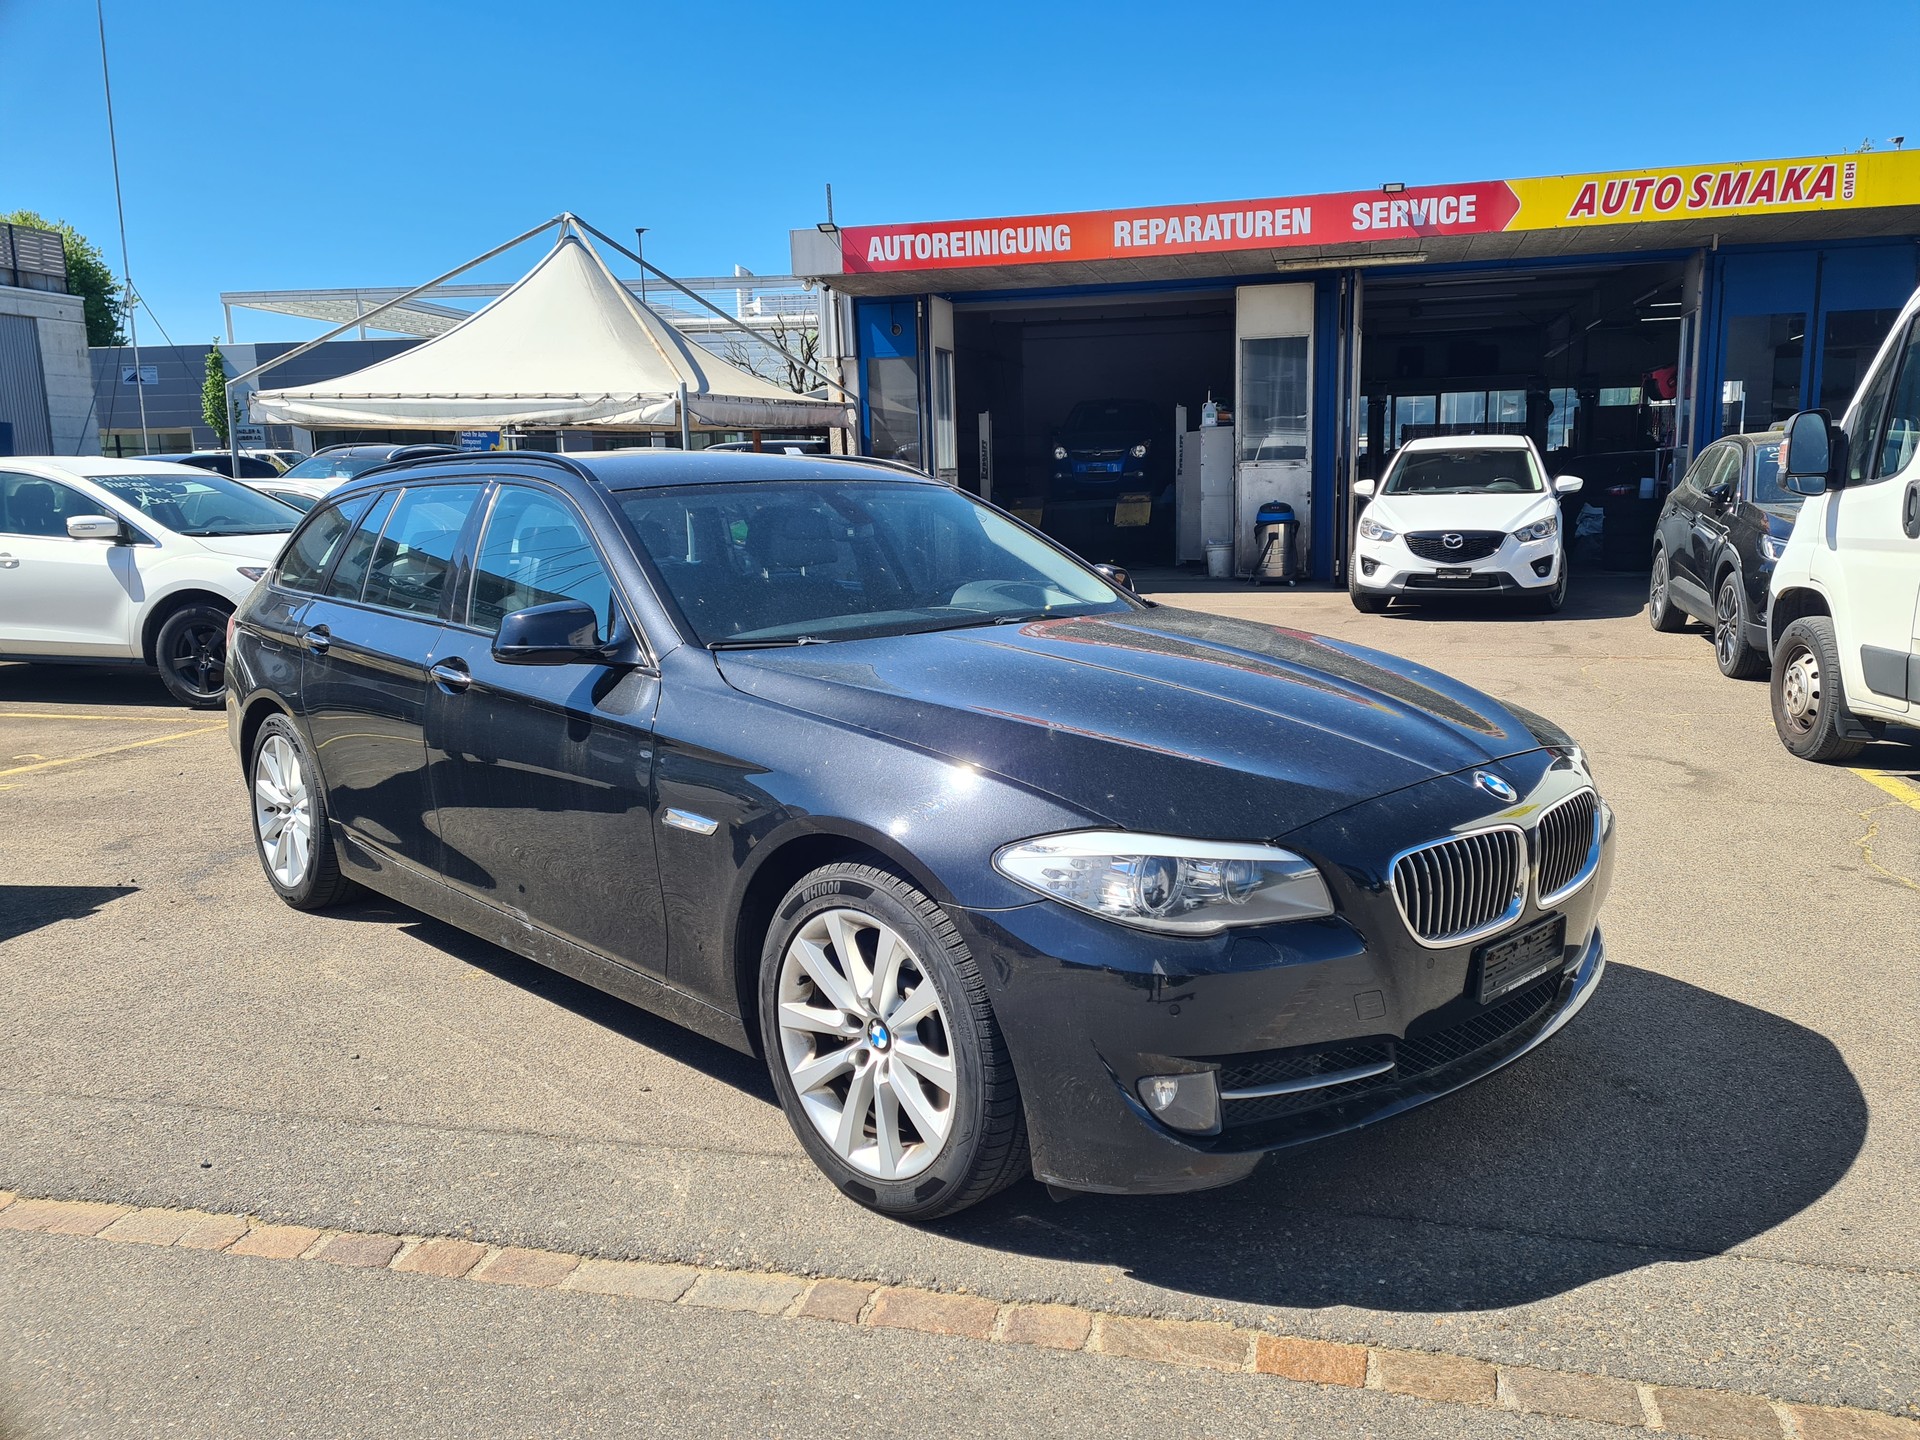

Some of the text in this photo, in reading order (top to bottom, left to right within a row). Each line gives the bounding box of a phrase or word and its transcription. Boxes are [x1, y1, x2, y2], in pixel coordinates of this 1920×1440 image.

[1568, 164, 1837, 218] AUTO SMAKA
[1843, 162, 1856, 199] GMBH
[867, 194, 1477, 263] AUTOREINIGUNG REPARATUREN SERVICE
[801, 880, 841, 903] WH1000
